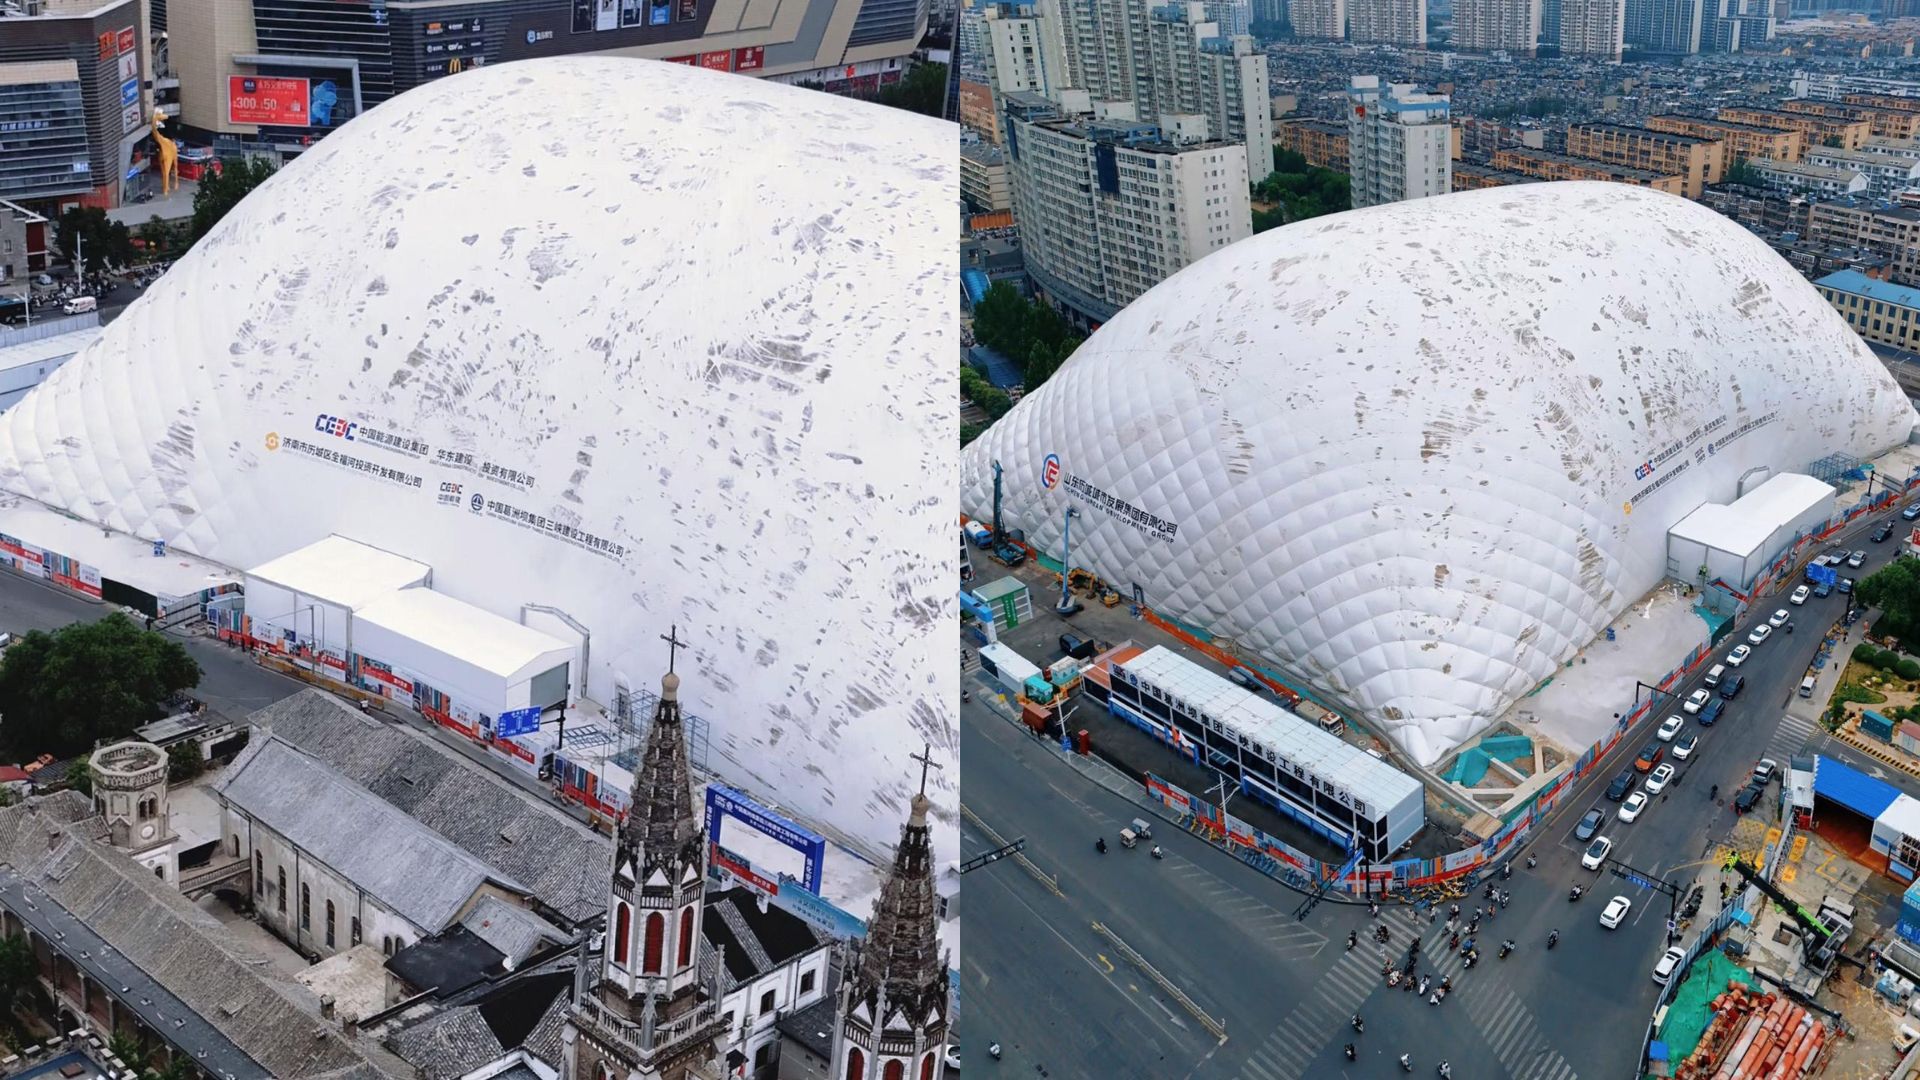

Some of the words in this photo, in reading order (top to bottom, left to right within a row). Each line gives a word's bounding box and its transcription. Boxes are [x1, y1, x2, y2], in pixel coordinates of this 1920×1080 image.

[359, 427, 429, 456] 中国能源建设集团
[482, 462, 535, 488] 投资有限公司
[487, 500, 625, 558] 中国葛洲坝集团三峡建设工程有限公司
[1151, 531, 1175, 544] GROUP
[1141, 680, 1366, 815] 中国葛洲坝集团三峡建设工程有限公司
